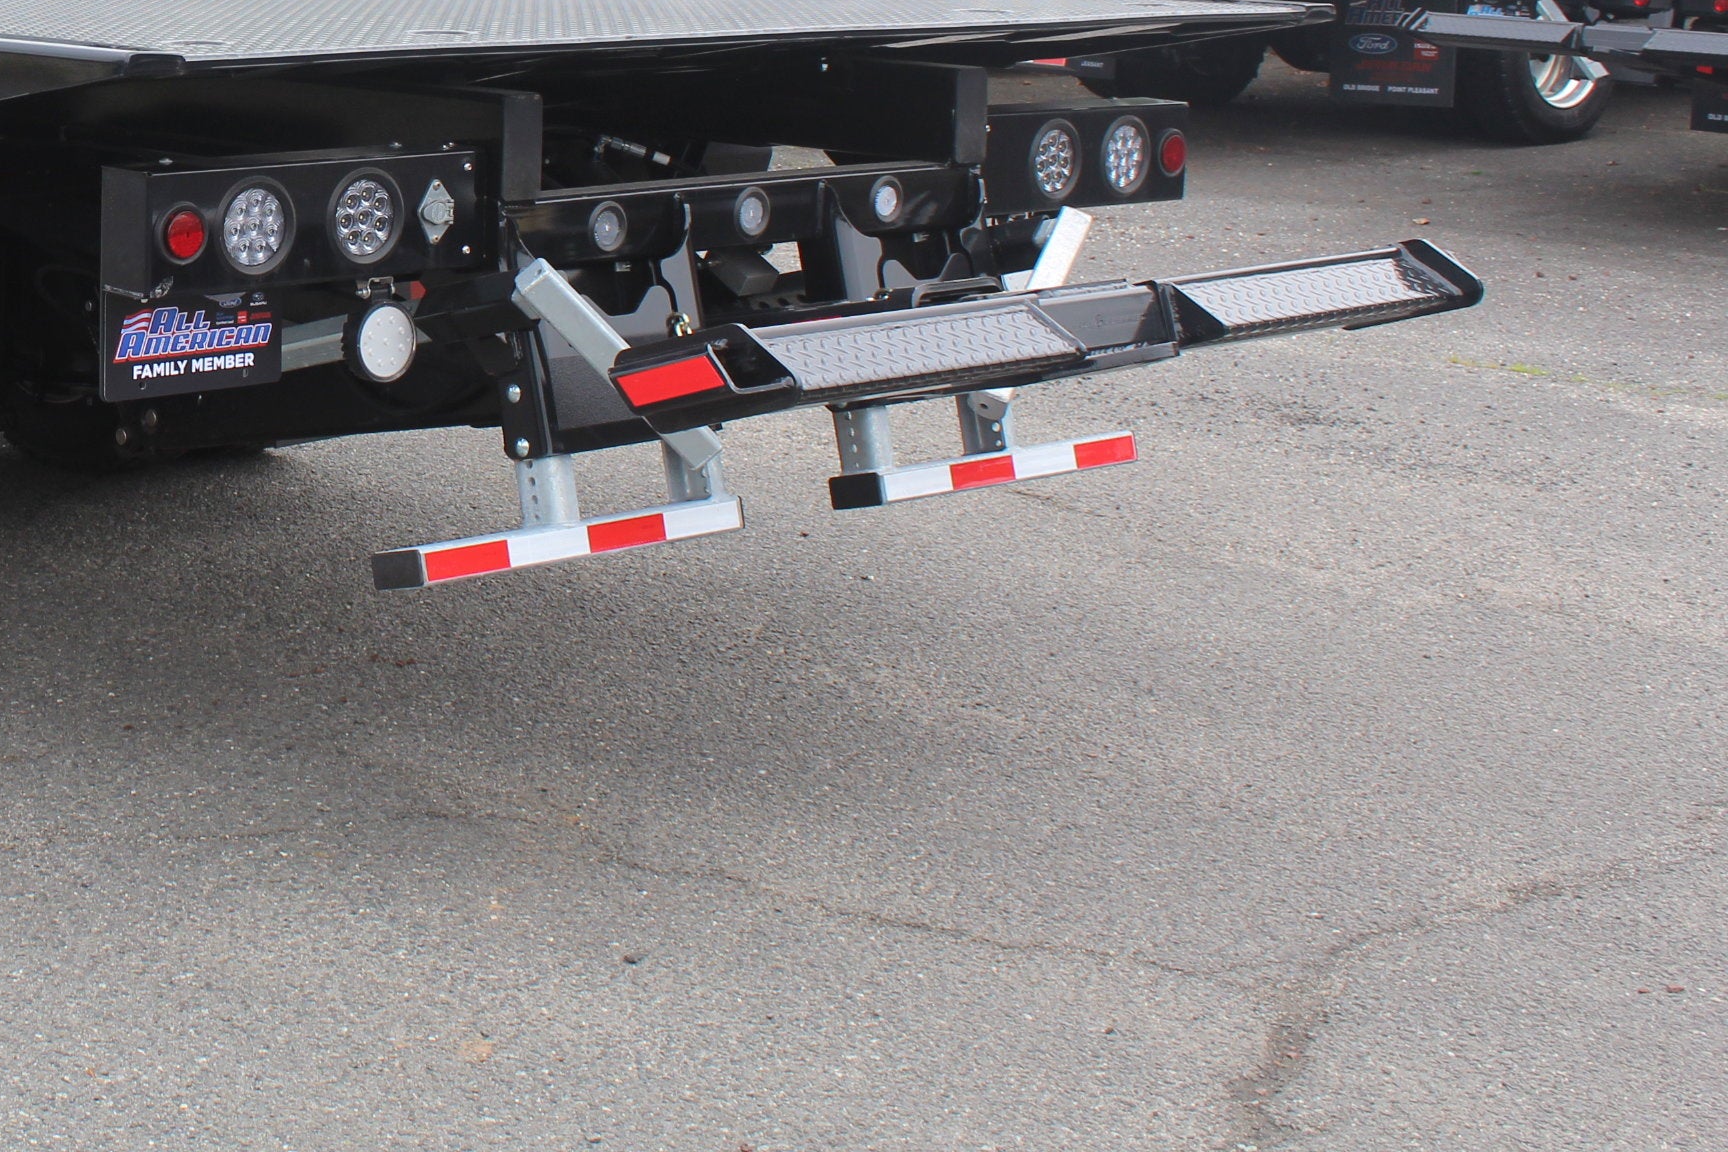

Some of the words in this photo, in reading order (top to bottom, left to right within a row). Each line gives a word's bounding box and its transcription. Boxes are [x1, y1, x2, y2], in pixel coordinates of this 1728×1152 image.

[149, 306, 211, 336] ALL
[114, 322, 273, 361] AMERICAN
[133, 360, 188, 380] FAMILY
[191, 352, 255, 373] MEMBER
